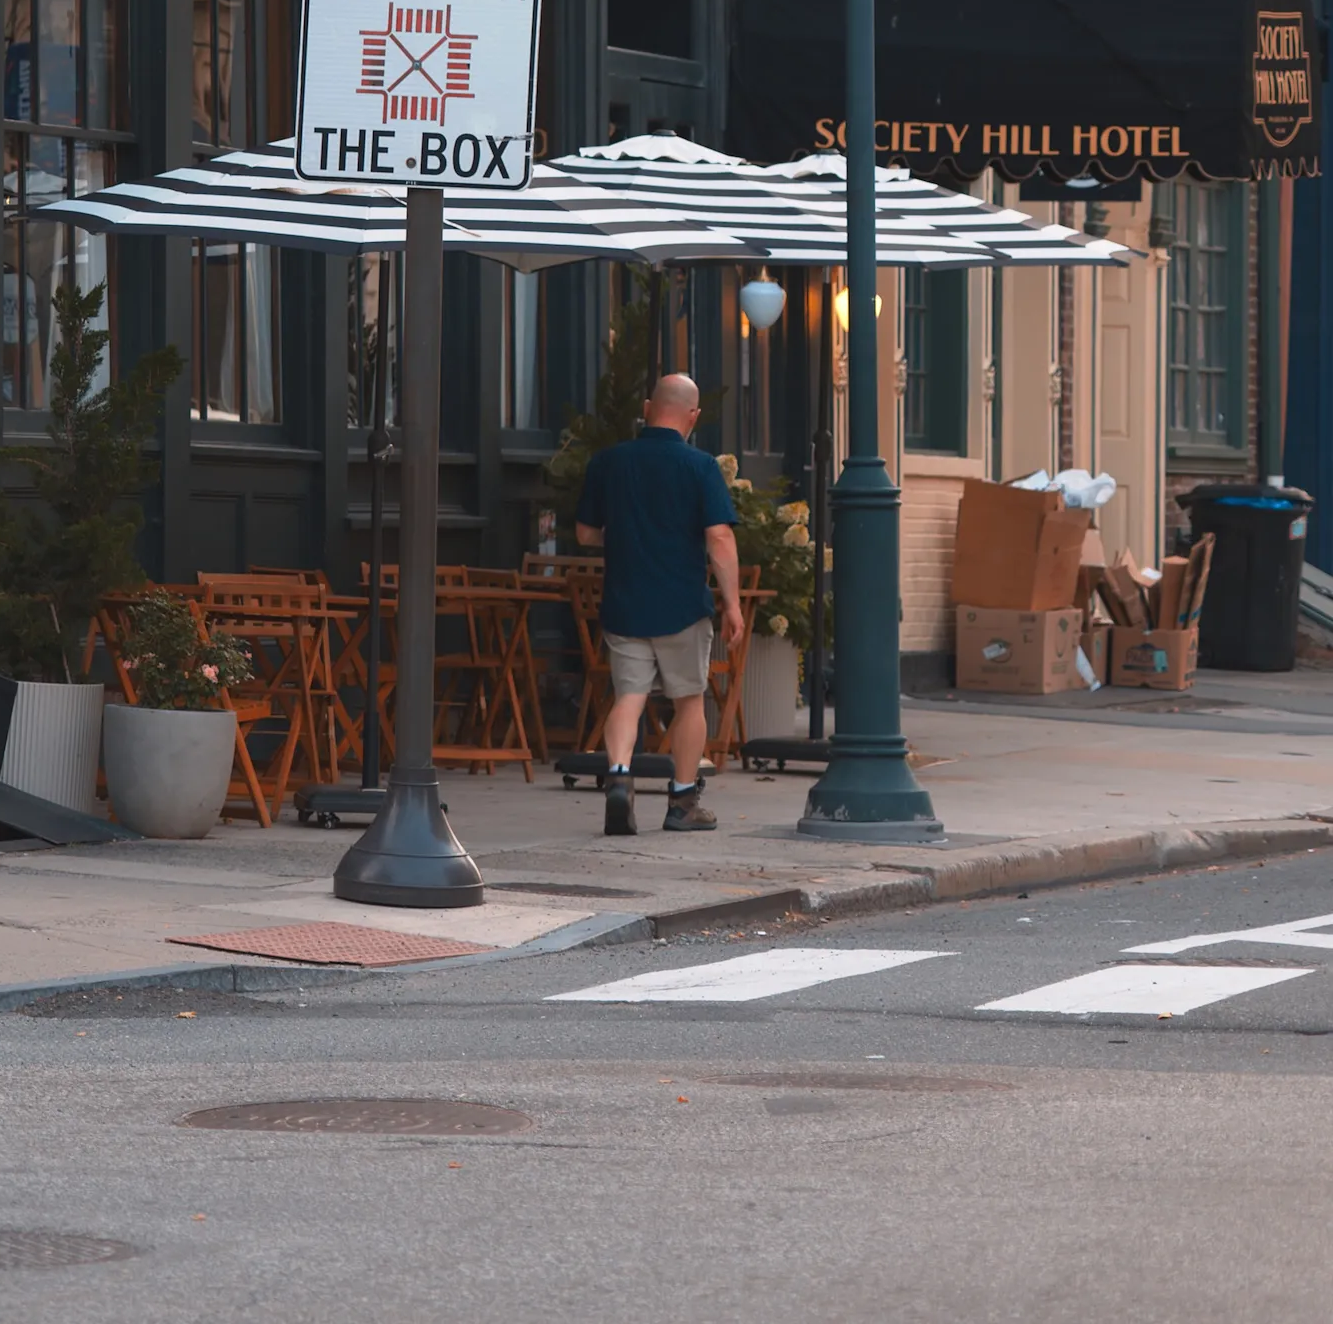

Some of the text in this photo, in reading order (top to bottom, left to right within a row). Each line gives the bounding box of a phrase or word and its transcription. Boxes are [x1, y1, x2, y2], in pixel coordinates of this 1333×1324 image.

[1259, 25, 1300, 60] SOCIETY
[1255, 70, 1309, 104] HILL HOTEL
[314, 127, 395, 174] THE
[420, 132, 513, 179] BOX
[983, 124, 1059, 156] HILL
[1073, 125, 1190, 158] HOTEL
